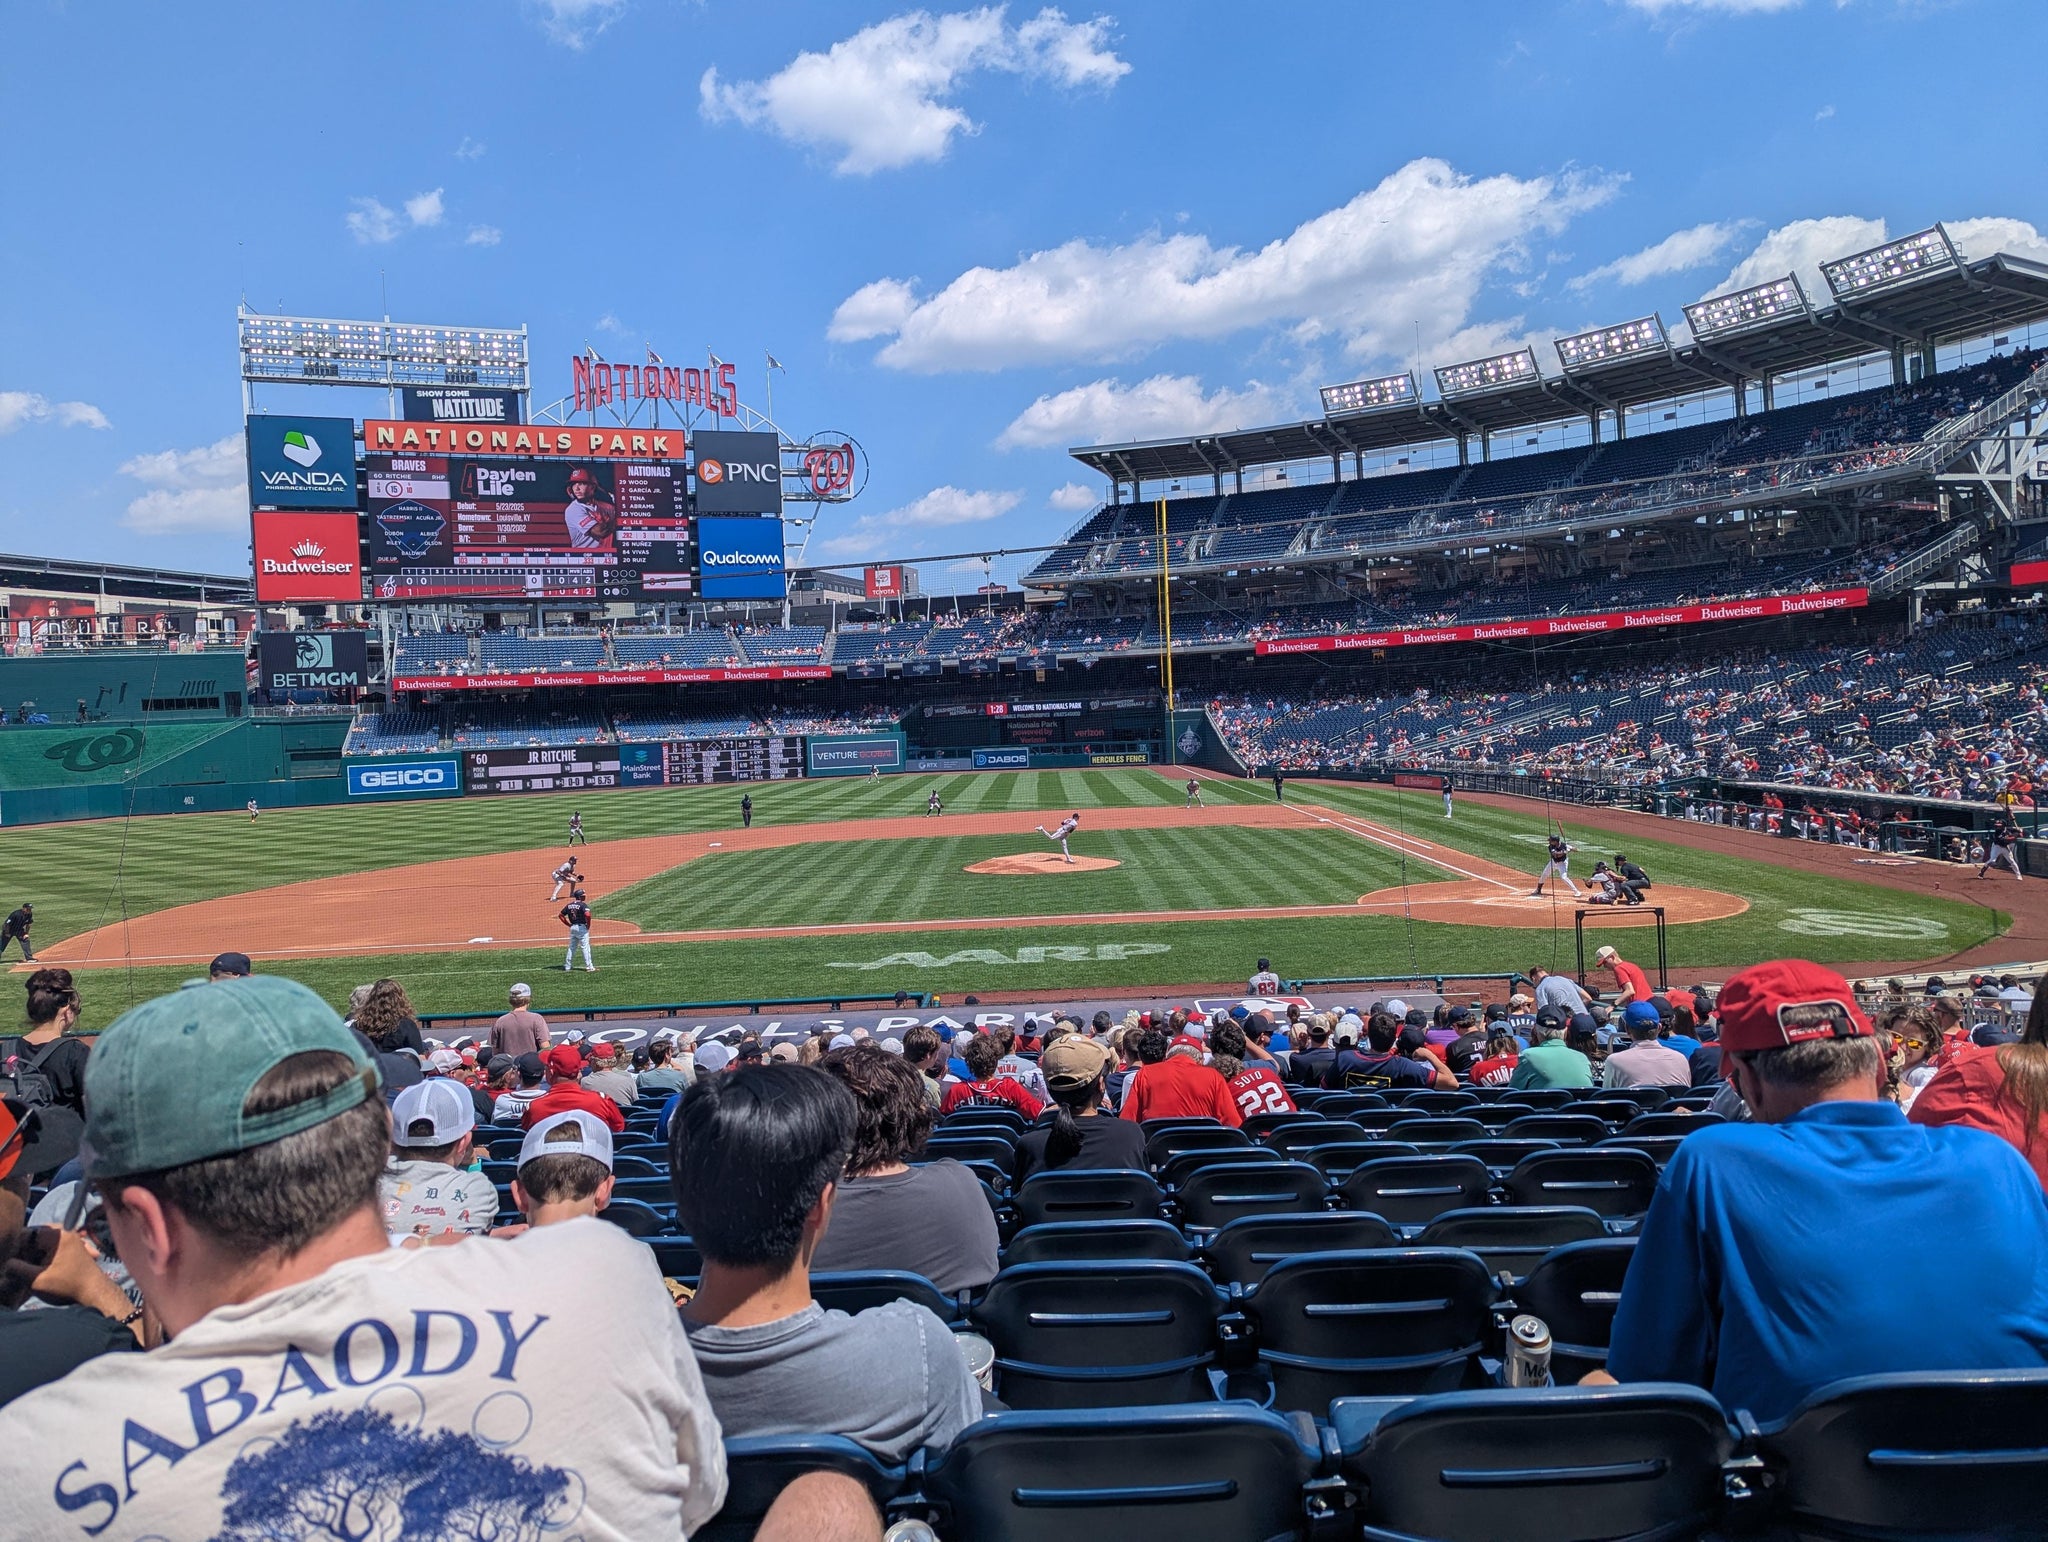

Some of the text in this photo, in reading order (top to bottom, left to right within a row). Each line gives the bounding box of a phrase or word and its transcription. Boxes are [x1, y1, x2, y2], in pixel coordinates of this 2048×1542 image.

[573, 356, 737, 417] NATIONALS
[433, 398, 504, 418] NATITUDE
[377, 426, 668, 451] NATIONALS PARK
[391, 459, 426, 471] BRAVES
[627, 465, 671, 477] NATIONALS
[260, 471, 348, 486] VANDA
[476, 467, 536, 483] Daylen
[725, 462, 777, 483] PNC
[390, 485, 398, 493] 15
[478, 480, 515, 496] Lile
[457, 502, 477, 510] Debut:
[457, 513, 492, 521] Hometown:
[523, 513, 530, 521] KY
[703, 550, 781, 566] Qualcomm
[262, 559, 353, 573] Budweiser
[406, 577, 413, 585] 0
[420, 577, 427, 585] 0
[586, 587, 592, 595] 2
[872, 588, 895, 596] TOYOTA
[1267, 595, 1847, 653] Budweiser Budweiser Budweiser Budweiser Budweiser Budweiser Budweiser Budweiser
[273, 672, 358, 687] BETMGM
[399, 669, 827, 689] Budweiser Budweiser Budweiser Budweiser Budweiser Budweiser Budweiser
[990, 704, 1004, 714] 1:28
[1012, 704, 1035, 712] WELCOME
[1035, 703, 1042, 711] TO
[1042, 702, 1069, 711] NATIONALS
[1007, 720, 1058, 729] Nationals Park
[1012, 728, 1053, 737] powered by
[1073, 728, 1105, 737] verizon
[528, 751, 539, 764] JR
[541, 750, 577, 763] RITCHIE
[816, 750, 894, 761] VENTURE GLOBAL
[988, 755, 1027, 764] DABOS
[1092, 755, 1147, 764] HERCULES FENCE
[622, 764, 661, 772] MainStreet
[360, 768, 444, 787] GEICO
[632, 771, 652, 780] Bank
[824, 943, 1172, 971] AARP
[1234, 1070, 1263, 1088] SOTO
[1237, 1081, 1290, 1117] 22
[53, 1309, 550, 1537] SABAODY
